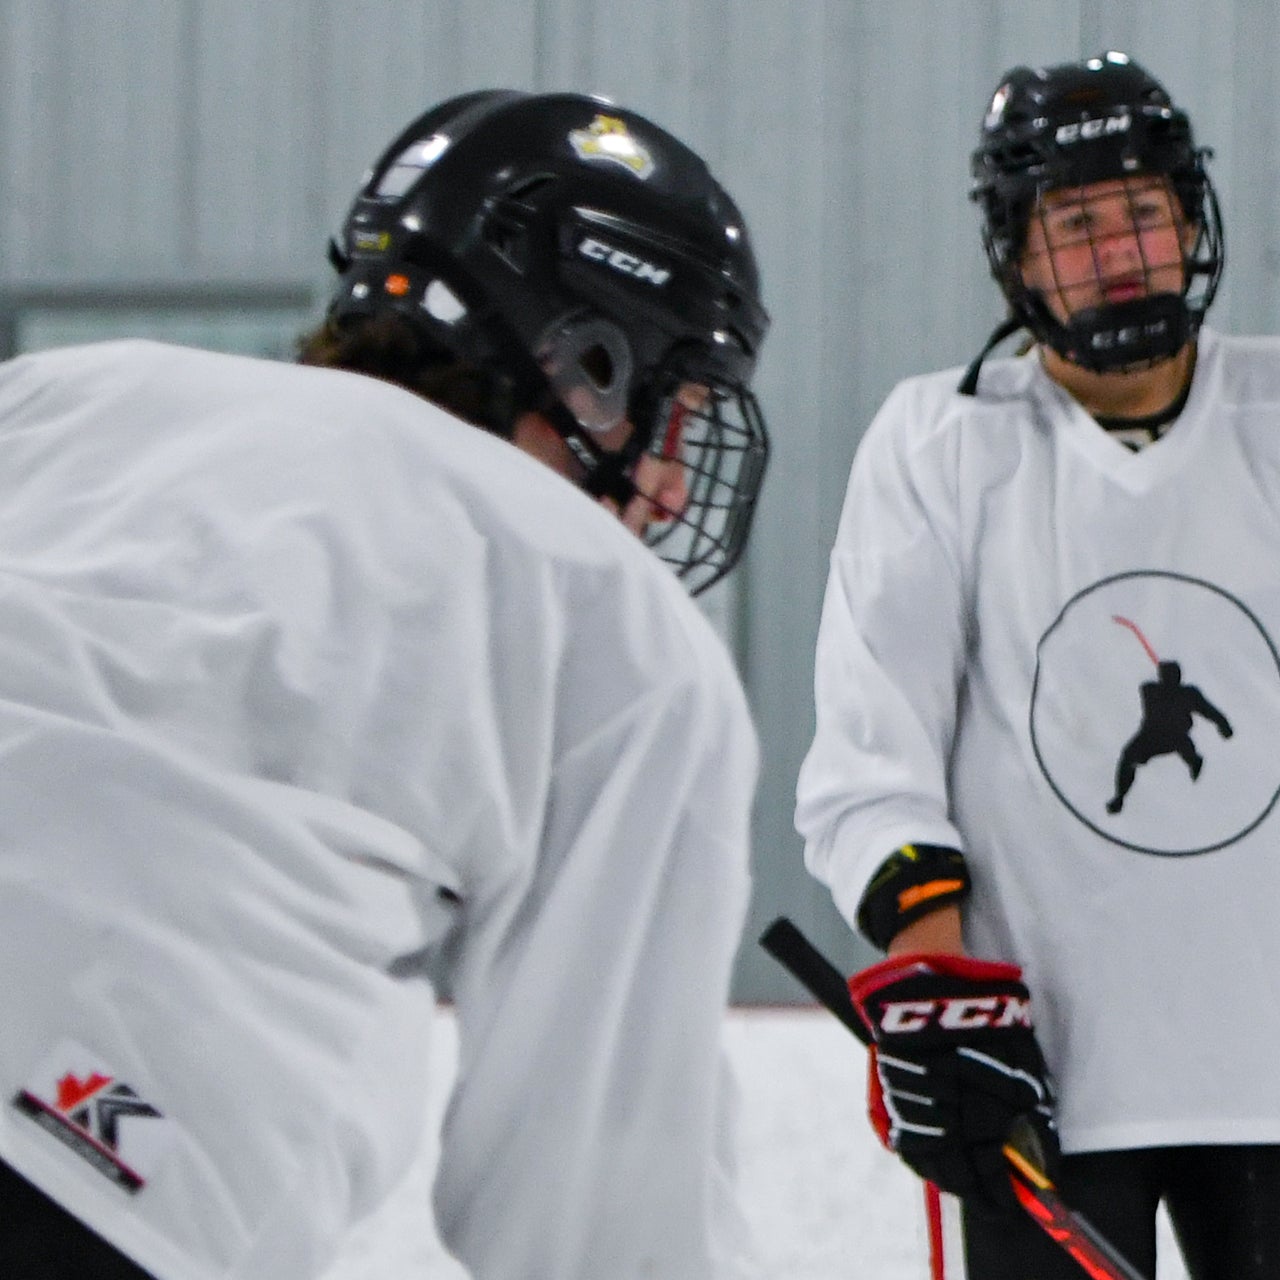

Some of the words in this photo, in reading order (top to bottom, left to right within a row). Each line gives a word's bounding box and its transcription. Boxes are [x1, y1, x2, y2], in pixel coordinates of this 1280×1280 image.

[1055, 114, 1132, 145] CCM
[579, 237, 671, 286] CCM
[880, 996, 1032, 1034] CCM
